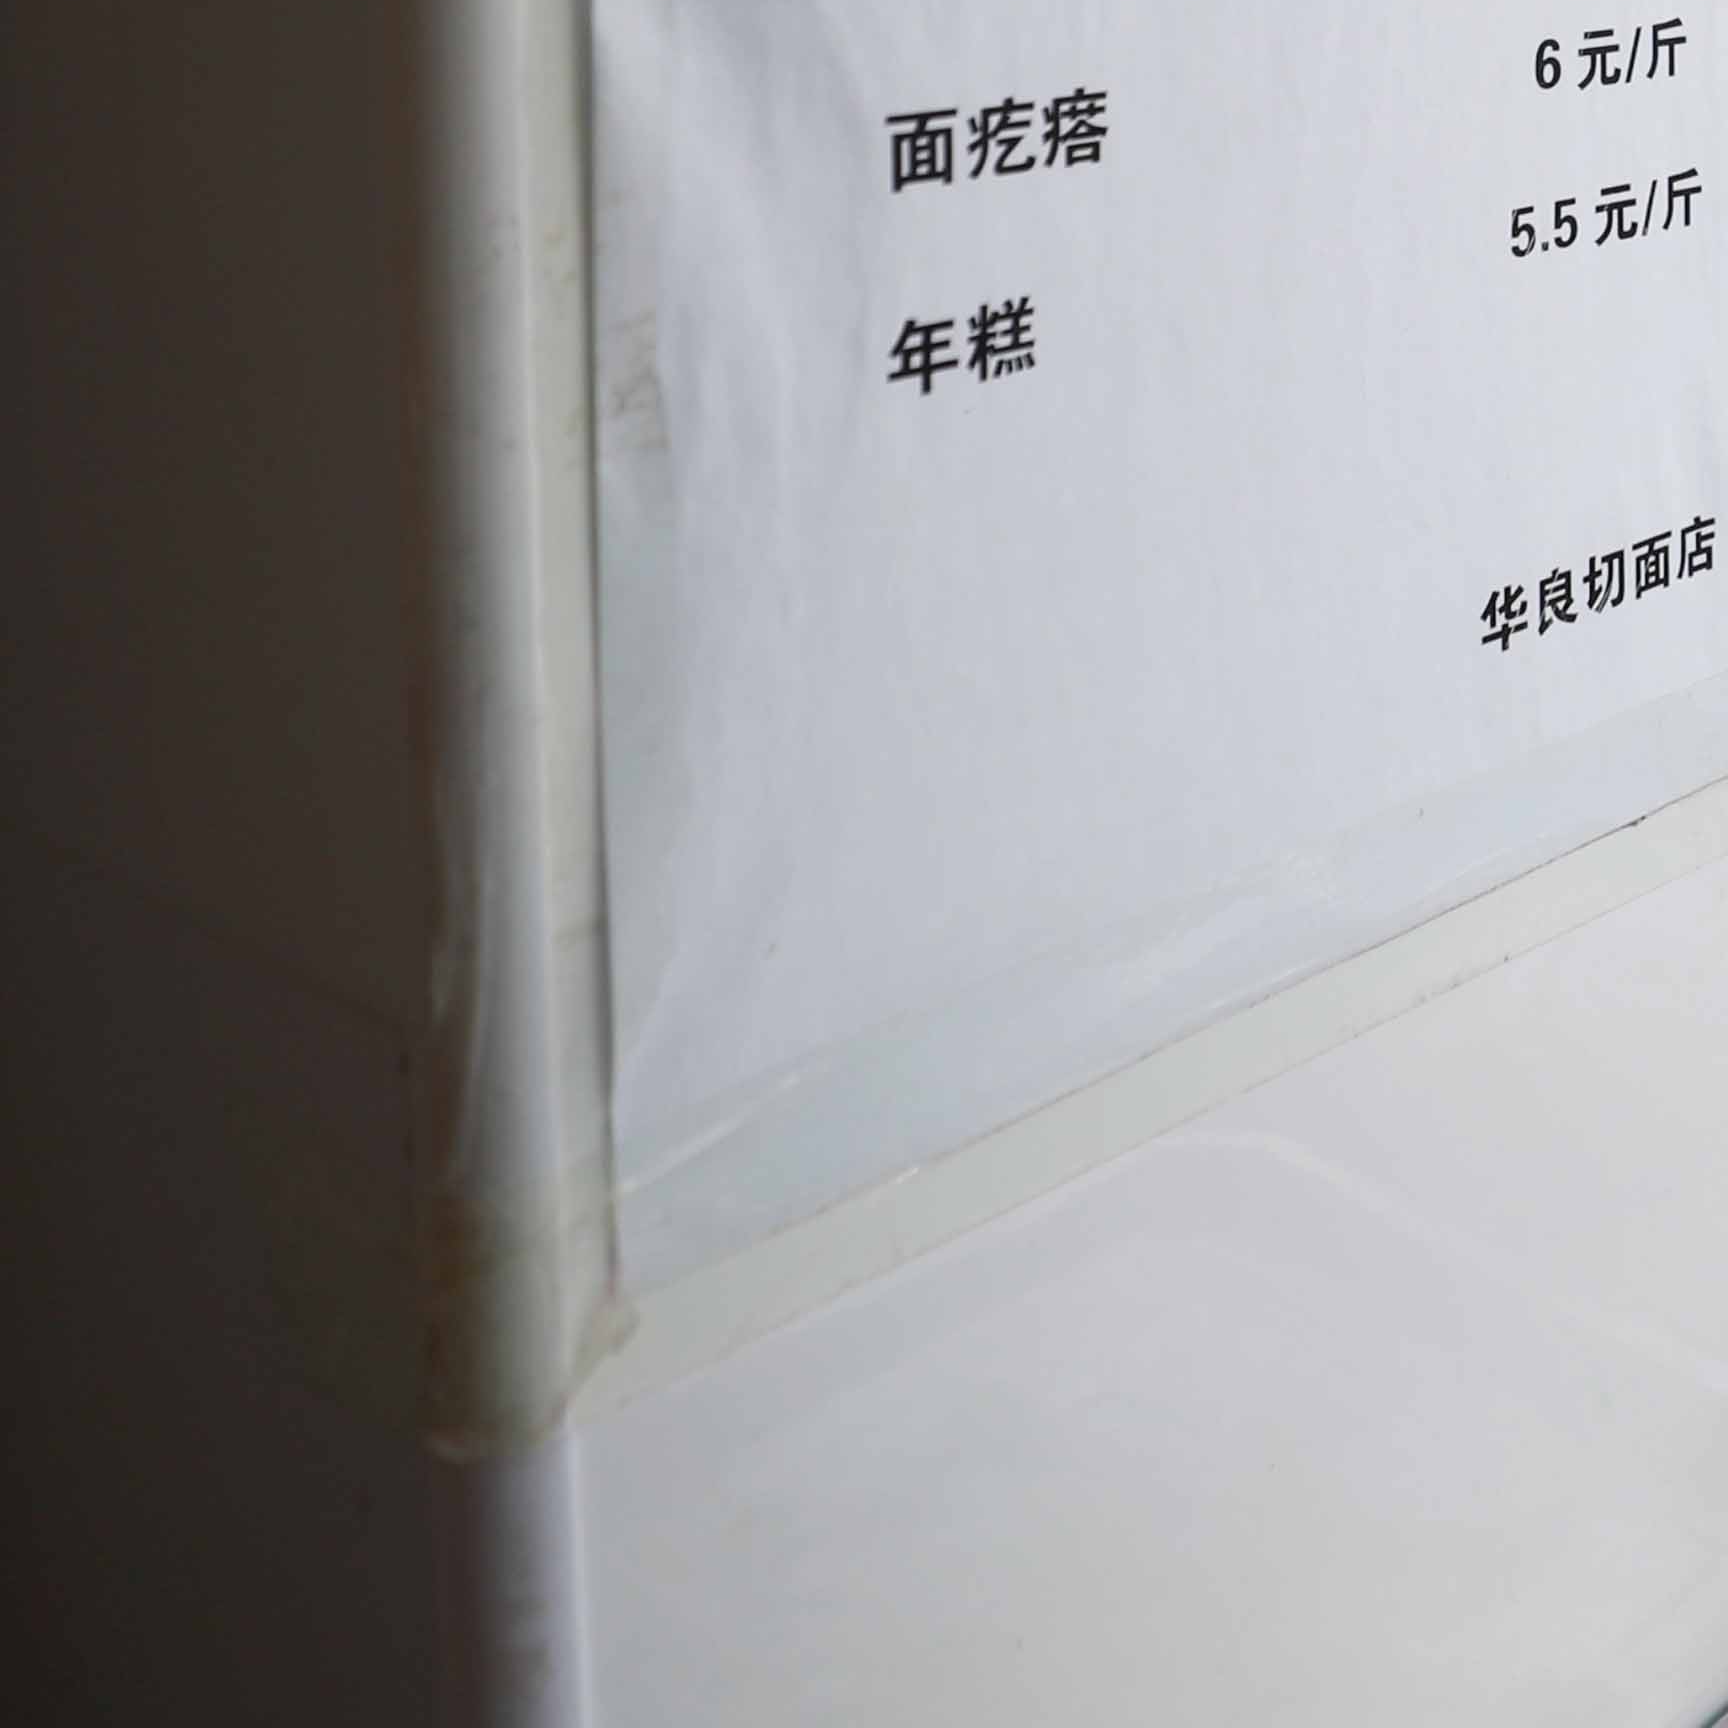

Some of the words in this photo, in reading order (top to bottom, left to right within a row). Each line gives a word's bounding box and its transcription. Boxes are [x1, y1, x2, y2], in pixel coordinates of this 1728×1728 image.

[884, 86, 1109, 194] 面疙瘩
[886, 295, 1036, 396] 年糕
[1479, 515, 1717, 653] 华良切面店
